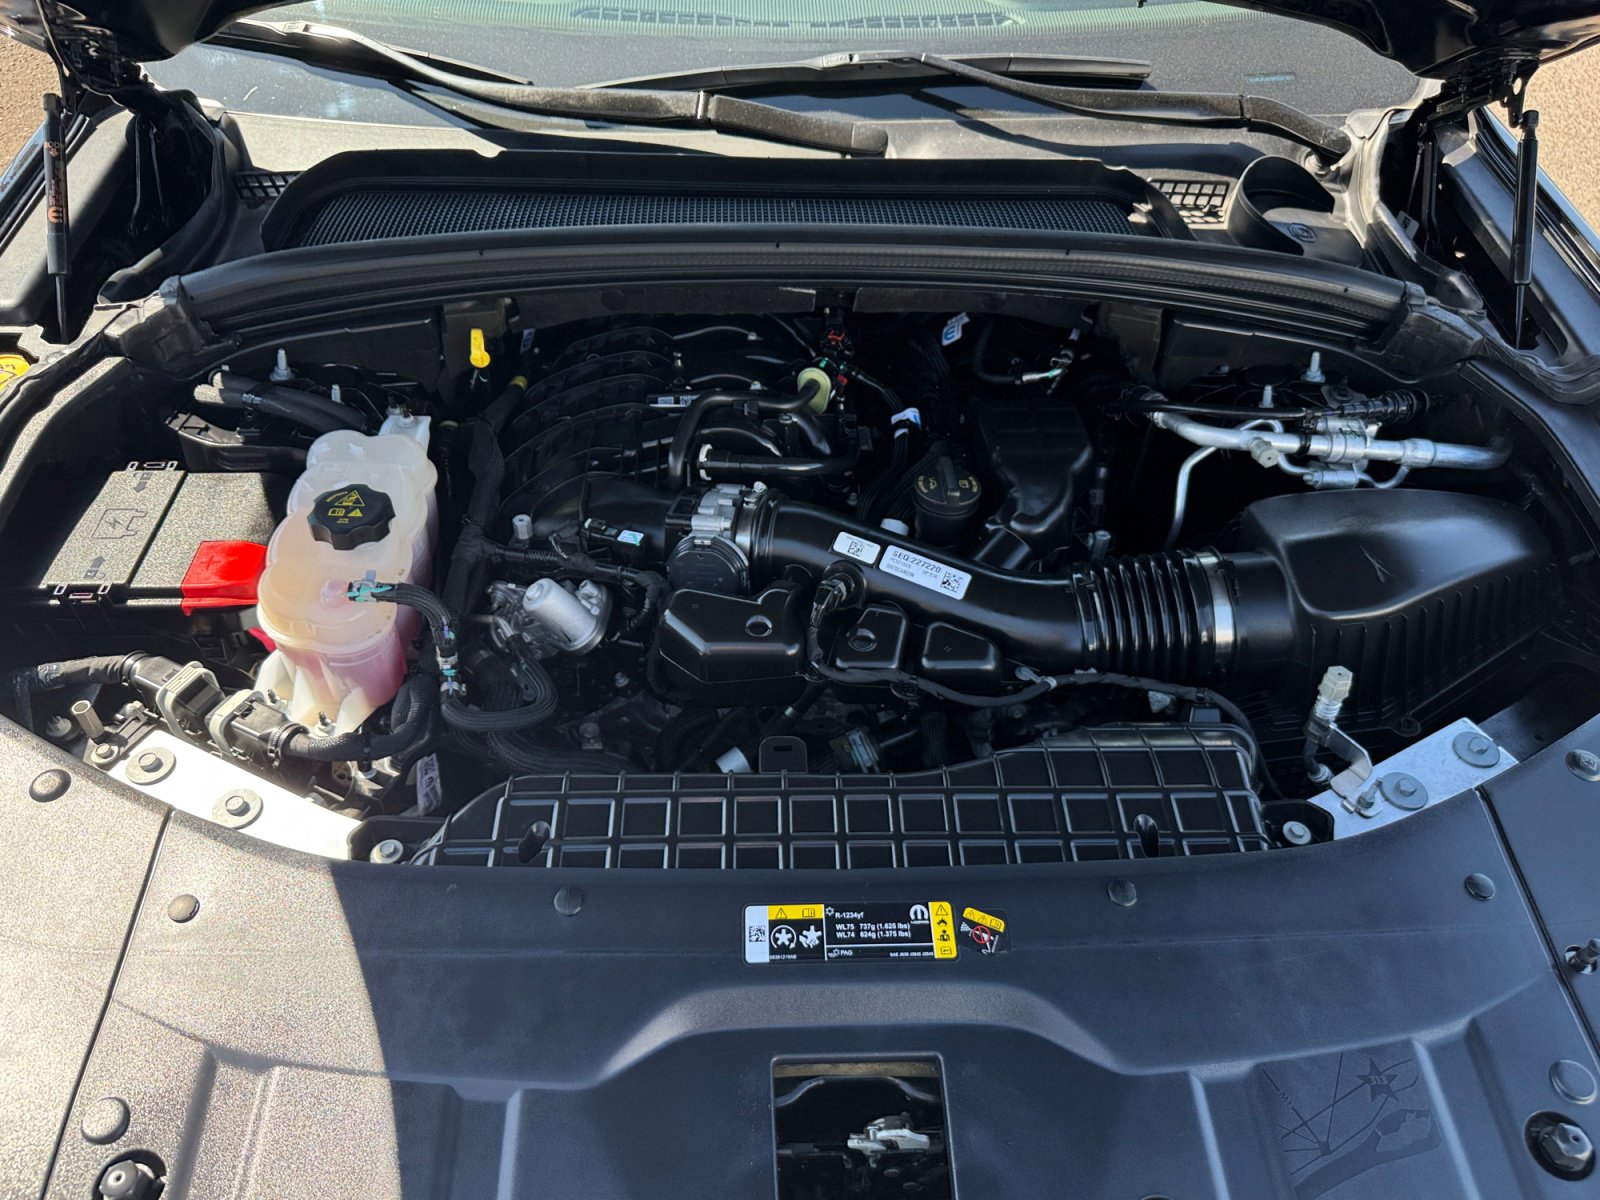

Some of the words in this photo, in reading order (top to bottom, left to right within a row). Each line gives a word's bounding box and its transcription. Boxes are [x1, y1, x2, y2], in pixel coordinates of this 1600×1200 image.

[892, 550, 941, 573] SEQ:227220
[835, 911, 864, 920] R-1234yf
[835, 923, 855, 931] WL75
[859, 923, 876, 932] 737g
[876, 922, 897, 931] (1.625
[897, 922, 911, 930] lbs)
[836, 931, 855, 939] WL74
[859, 931, 876, 939] 624g
[877, 930, 898, 939] (1.375
[898, 930, 912, 939] lbs)
[840, 949, 853, 957] PAG
[1368, 1075, 1388, 1085] 313
